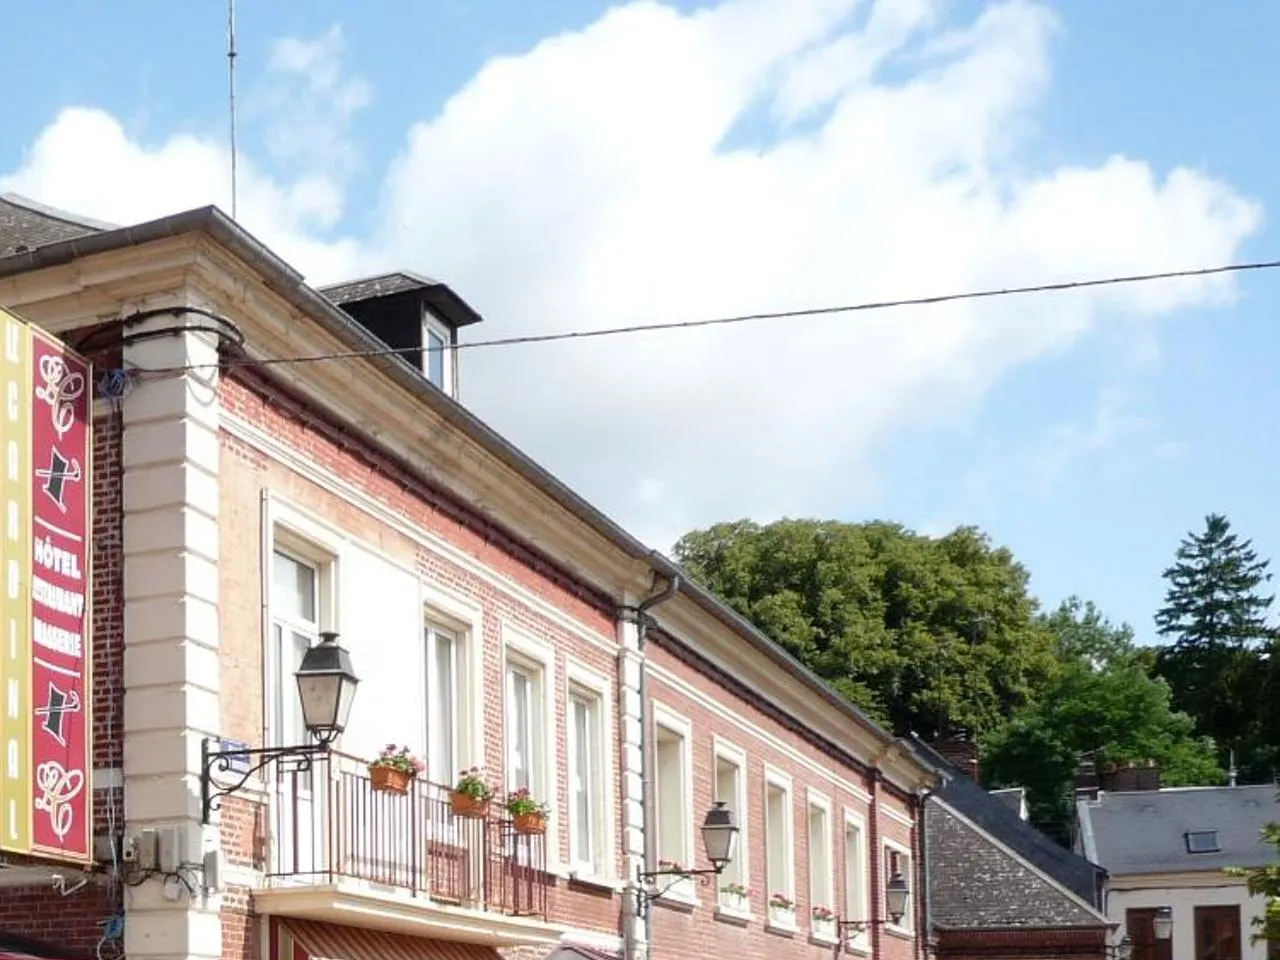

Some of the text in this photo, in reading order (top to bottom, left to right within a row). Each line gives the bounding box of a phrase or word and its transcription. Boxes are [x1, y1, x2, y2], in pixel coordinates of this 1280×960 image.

[6, 320, 19, 840] LE CARDINAL
[34, 535, 81, 580] HÔTEL
